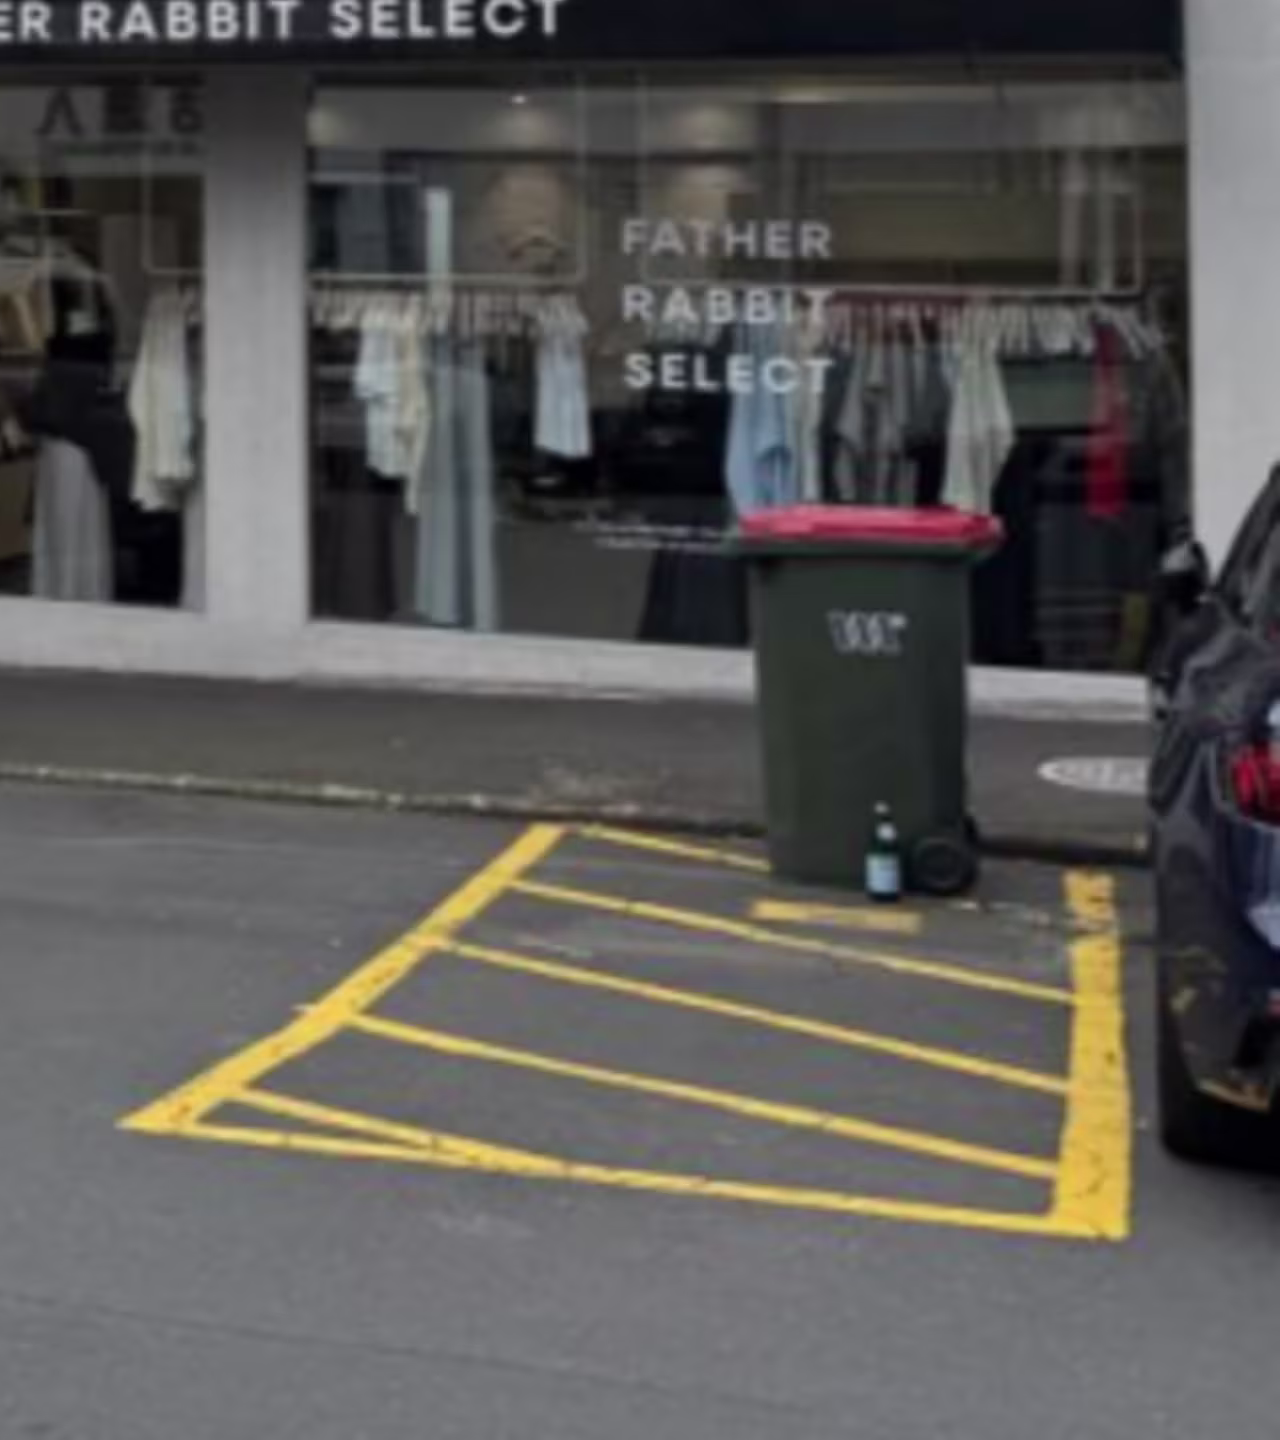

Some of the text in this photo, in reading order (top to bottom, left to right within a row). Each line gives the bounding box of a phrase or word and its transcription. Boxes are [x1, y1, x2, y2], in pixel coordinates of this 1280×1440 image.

[621, 217, 833, 258] FATHER
[621, 282, 834, 324] RABBIT
[622, 352, 834, 394] SELECT
